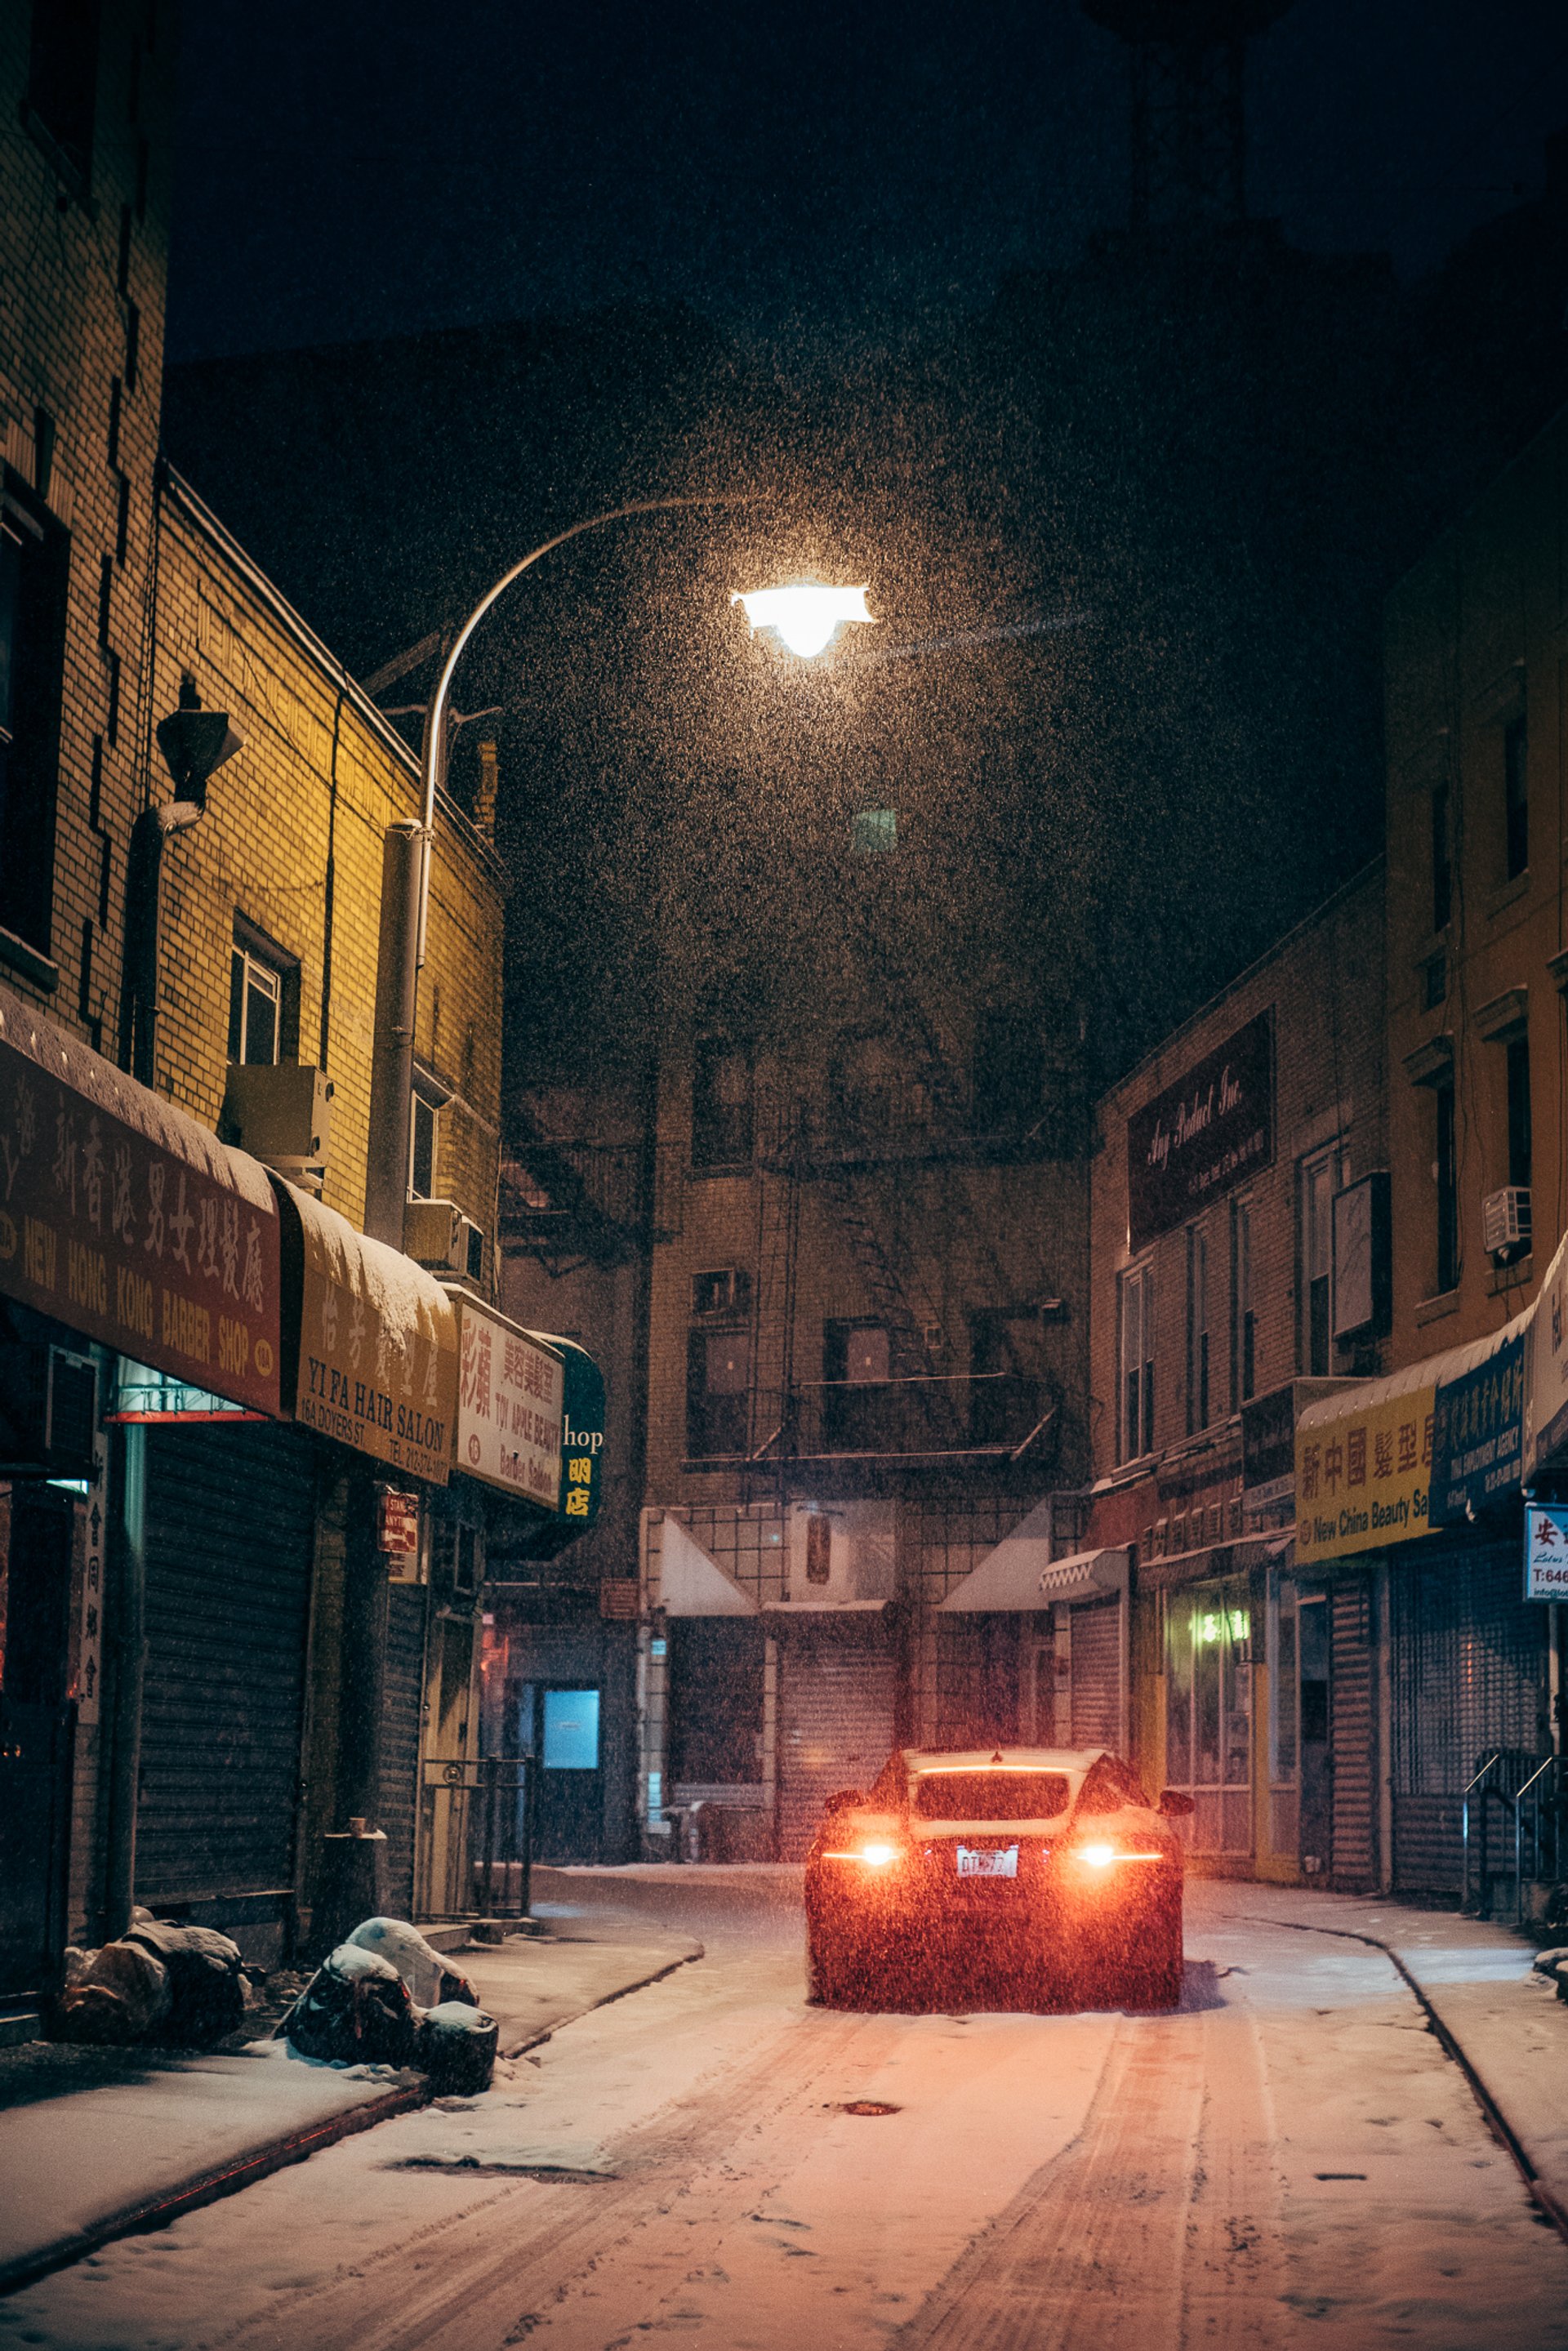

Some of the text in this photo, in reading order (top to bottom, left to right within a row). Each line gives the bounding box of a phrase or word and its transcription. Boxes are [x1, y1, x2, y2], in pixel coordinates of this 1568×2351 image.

[24, 1213, 56, 1292] NEW
[68, 1238, 108, 1316] HONG
[117, 1265, 154, 1340] KONG
[163, 1287, 210, 1365] BARBER
[219, 1314, 249, 1377] SHOP
[309, 1356, 445, 1453] YI FA HAIR SALON
[318, 1403, 353, 1443] DOYERS
[563, 1414, 604, 1455] hop
[1313, 1516, 1336, 1543] New
[1339, 1507, 1368, 1537] China
[1372, 1496, 1410, 1529] Beauty
[1413, 1488, 1429, 1518] Sa
